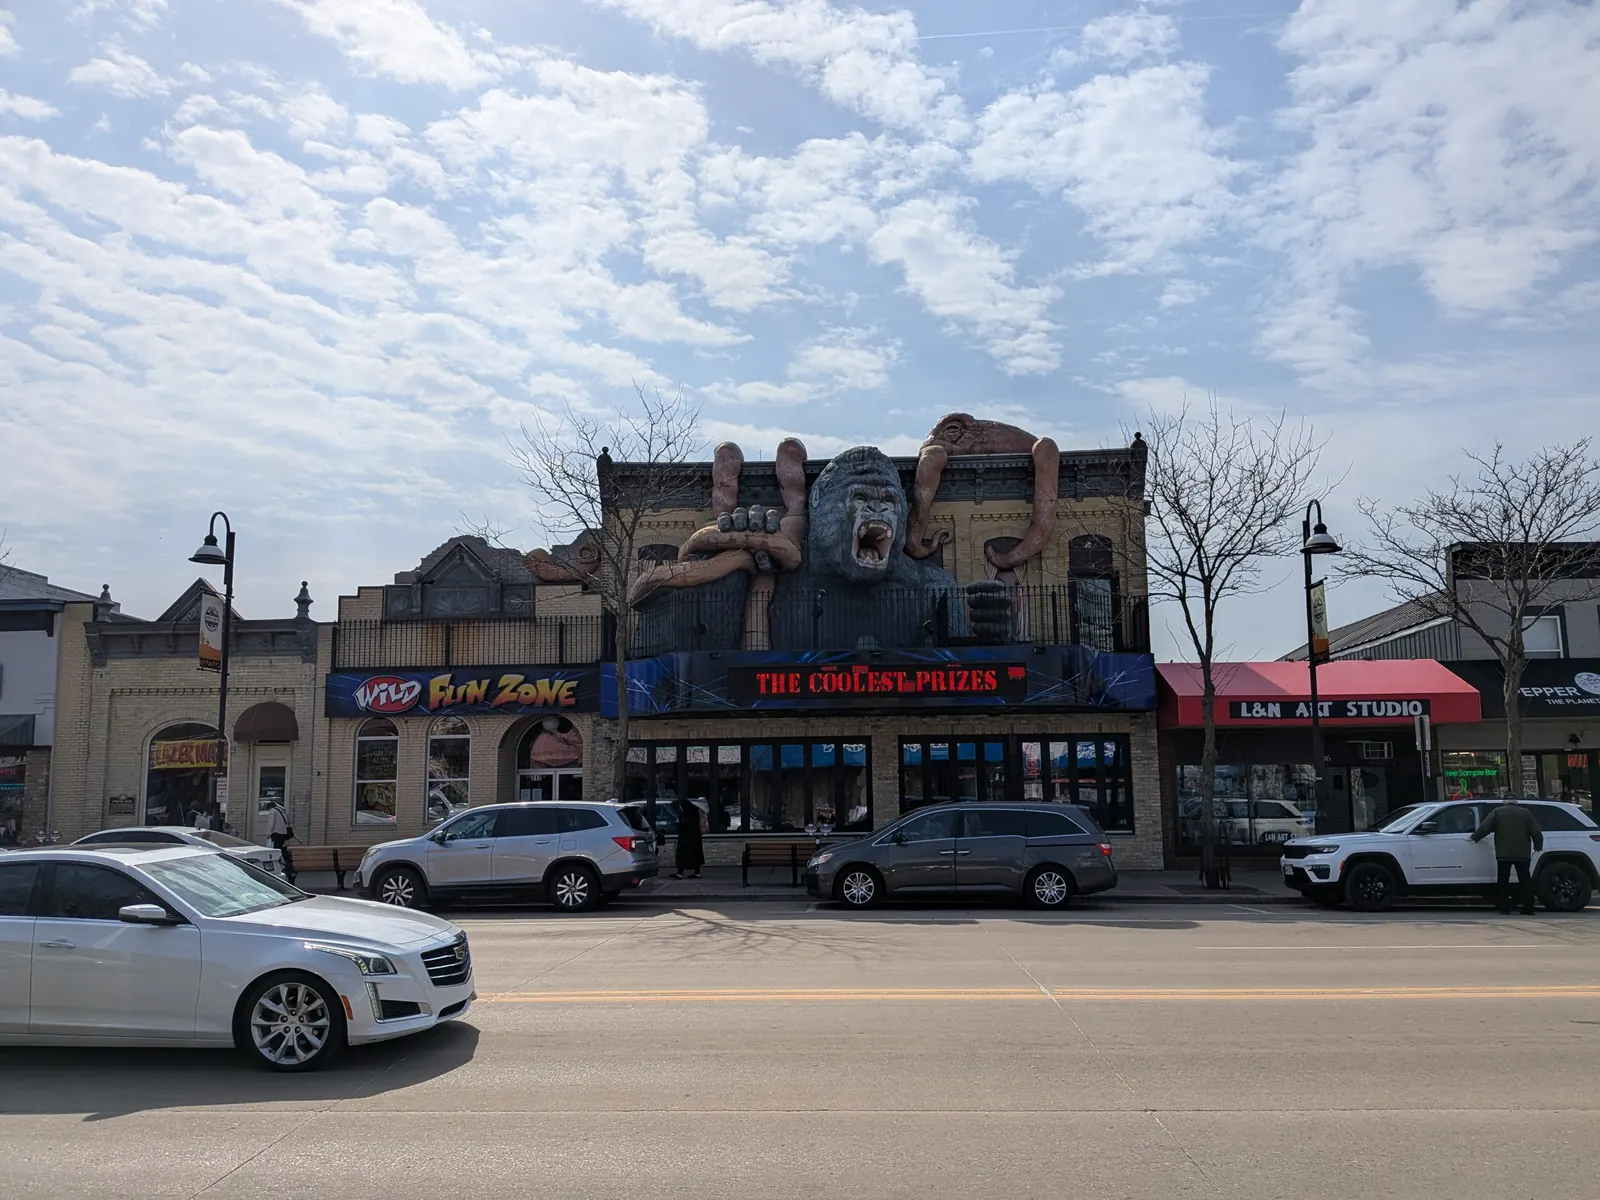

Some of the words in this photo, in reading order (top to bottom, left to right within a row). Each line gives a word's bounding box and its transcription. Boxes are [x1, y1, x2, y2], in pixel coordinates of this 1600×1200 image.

[756, 673, 800, 694] THE
[809, 671, 906, 693] COOLEST
[916, 670, 997, 692] PRIZES
[1517, 686, 1581, 697] EPPER
[1240, 702, 1281, 718] L&N
[1347, 700, 1422, 716] STUDIO
[1459, 768, 1485, 778] Sample
[1485, 768, 1497, 776] Bar
